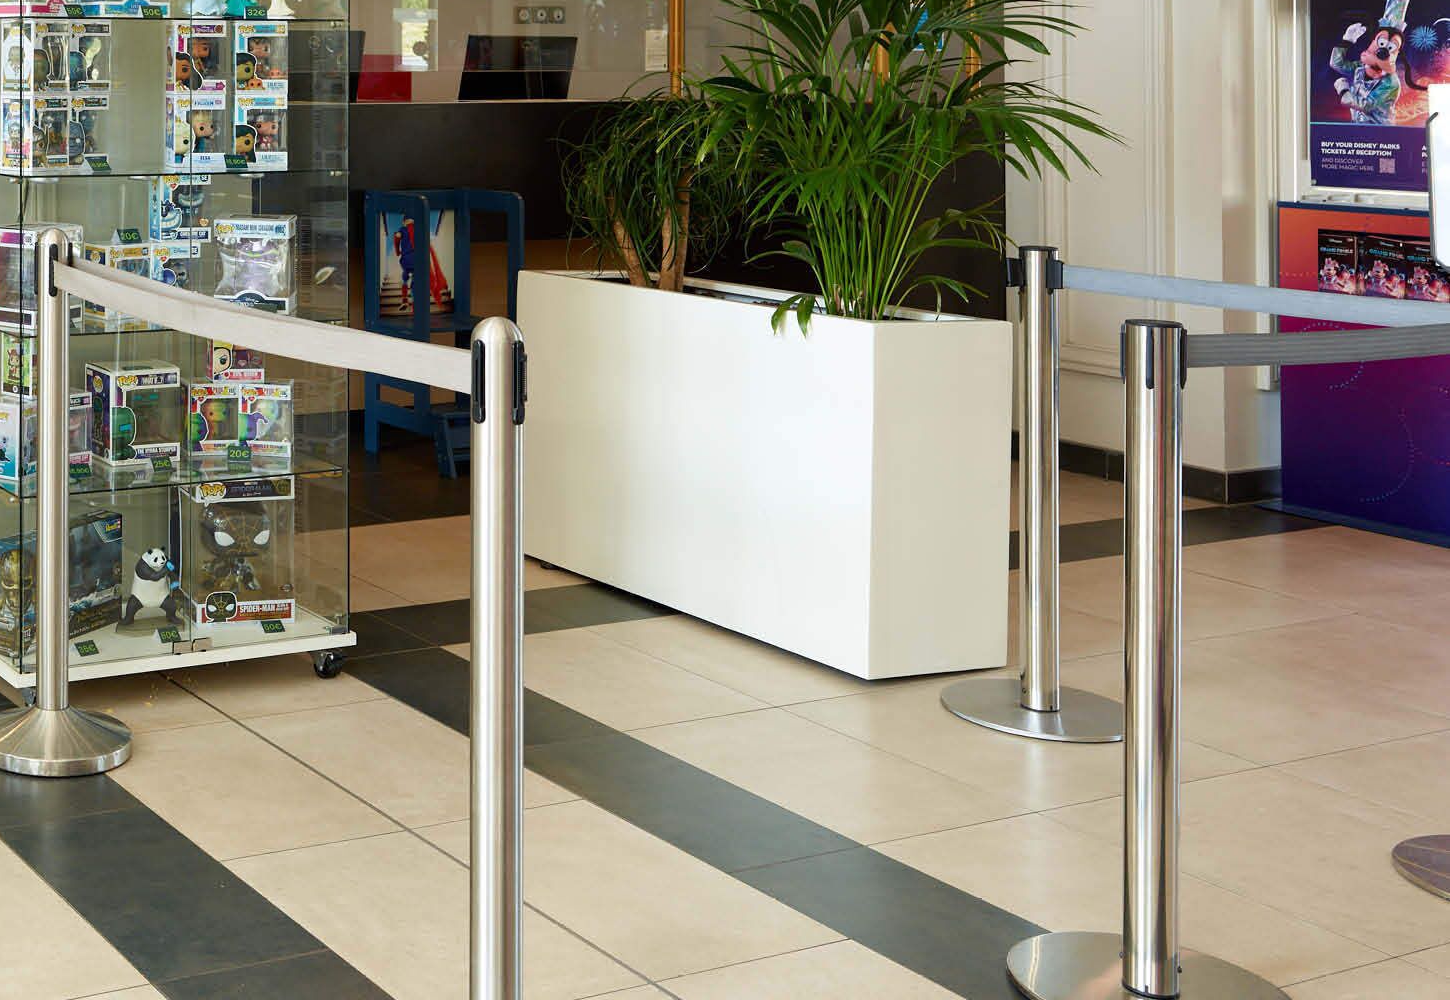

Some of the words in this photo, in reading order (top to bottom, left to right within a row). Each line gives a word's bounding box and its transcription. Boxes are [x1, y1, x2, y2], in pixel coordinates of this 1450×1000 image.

[143, 8, 161, 16] 50€
[247, 8, 266, 16] 32€
[1356, 149, 1392, 157] RECEPTION
[229, 449, 250, 458] 20€
[201, 483, 226, 497] POP!
[240, 604, 276, 614] SPIDER-MAN
